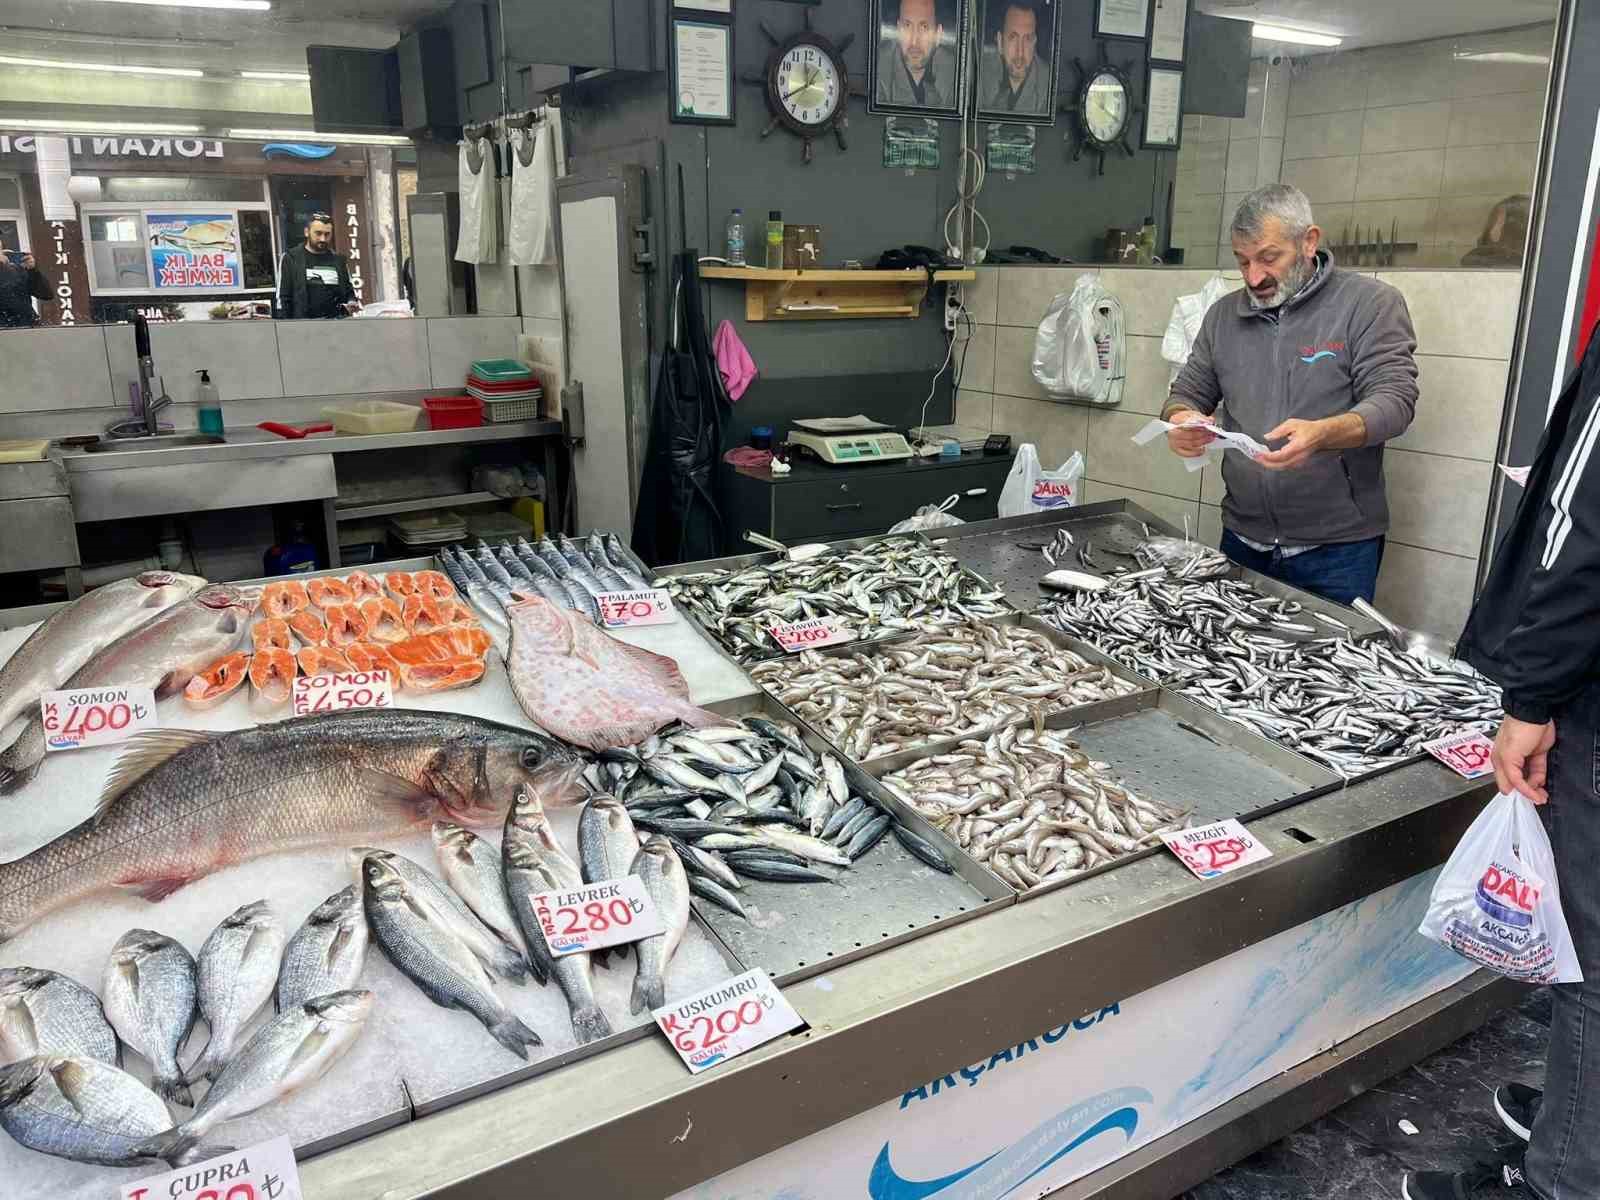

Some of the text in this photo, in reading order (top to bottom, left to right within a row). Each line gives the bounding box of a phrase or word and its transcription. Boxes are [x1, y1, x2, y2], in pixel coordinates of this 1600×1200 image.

[792, 51, 800, 62] 11
[804, 50, 814, 61] 12
[782, 61, 792, 72] 10
[296, 671, 387, 692] SOMON
[67, 690, 128, 706] SOMON
[44, 703, 59, 730] KG
[1183, 825, 1229, 844] MEZGİT
[557, 884, 621, 906] LEVREK
[534, 895, 556, 937] TANE
[677, 976, 758, 1019] USKUMRU
[168, 1157, 250, 1200] ÇUPRA
